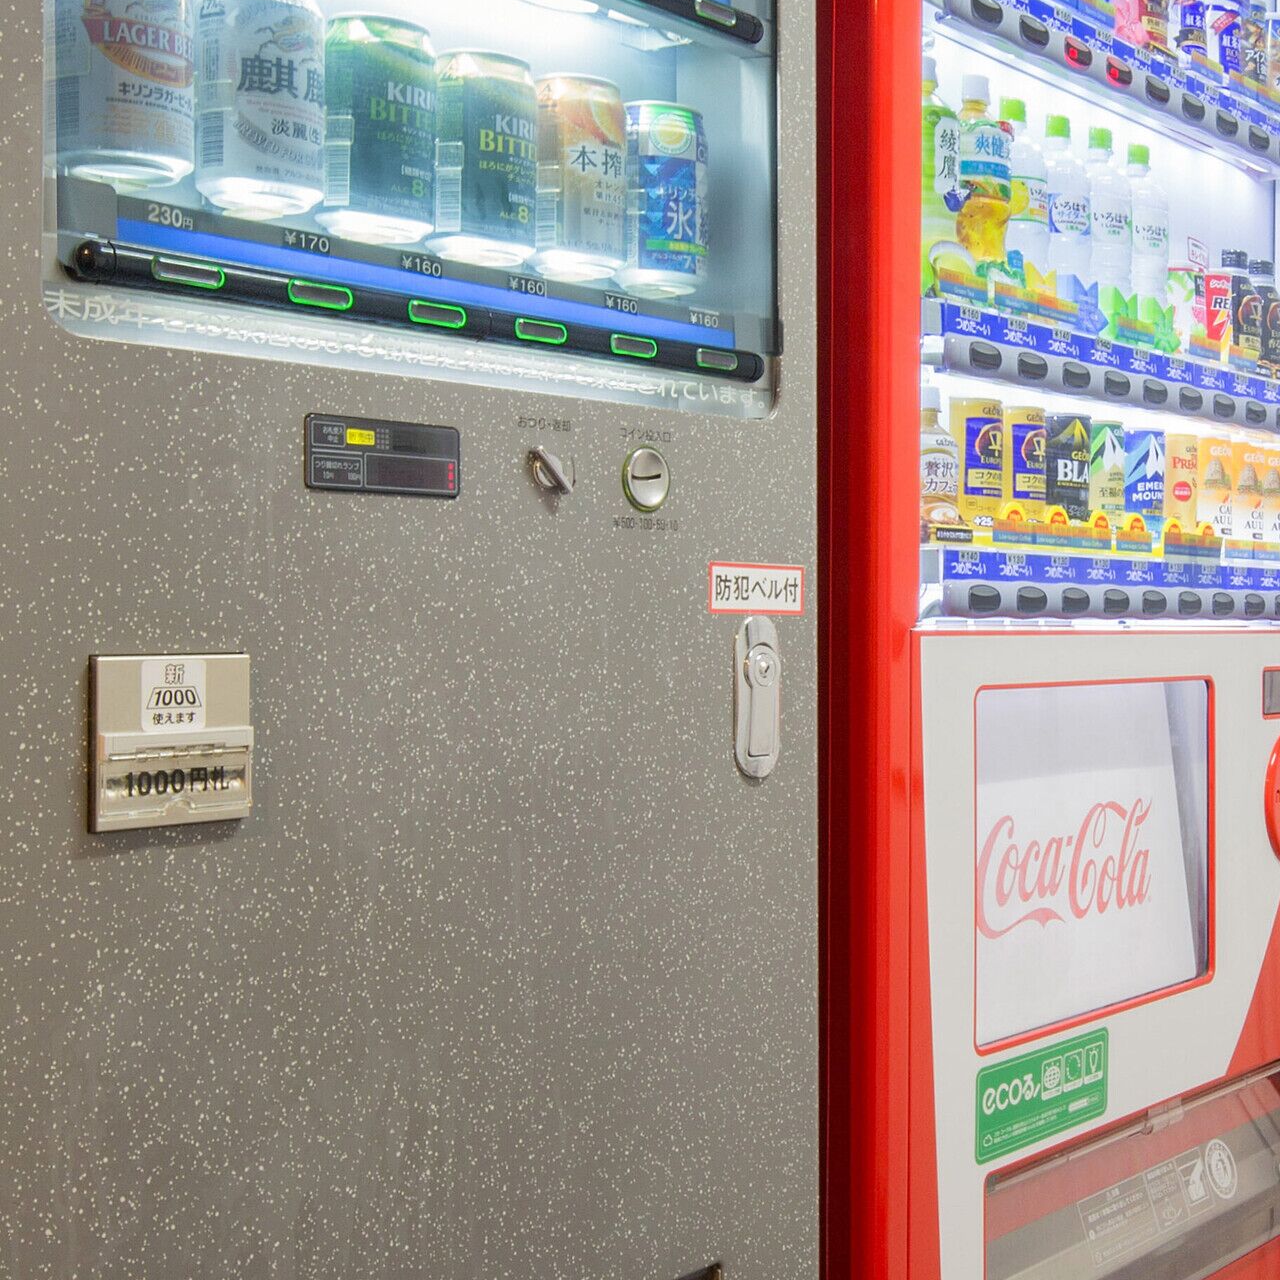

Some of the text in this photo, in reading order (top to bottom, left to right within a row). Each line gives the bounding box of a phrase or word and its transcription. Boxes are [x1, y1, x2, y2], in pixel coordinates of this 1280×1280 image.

[103, 20, 171, 50] LAGER
[939, 128, 958, 184] 綾鷹
[148, 205, 193, 231] 230円
[666, 201, 693, 239] 氷
[1094, 211, 1129, 225] いろはす
[285, 230, 329, 253] ¥170
[403, 255, 442, 277] ¥160
[509, 278, 544, 296] ¥160
[606, 295, 637, 314] ¥160
[690, 311, 719, 328] ¥160
[714, 571, 800, 606] 防犯ベル付
[165, 663, 185, 685] 新
[155, 689, 196, 706] 1000
[152, 712, 197, 726] 使えます
[126, 766, 229, 798] 1000円札
[976, 797, 1154, 940] Coca-Cola
